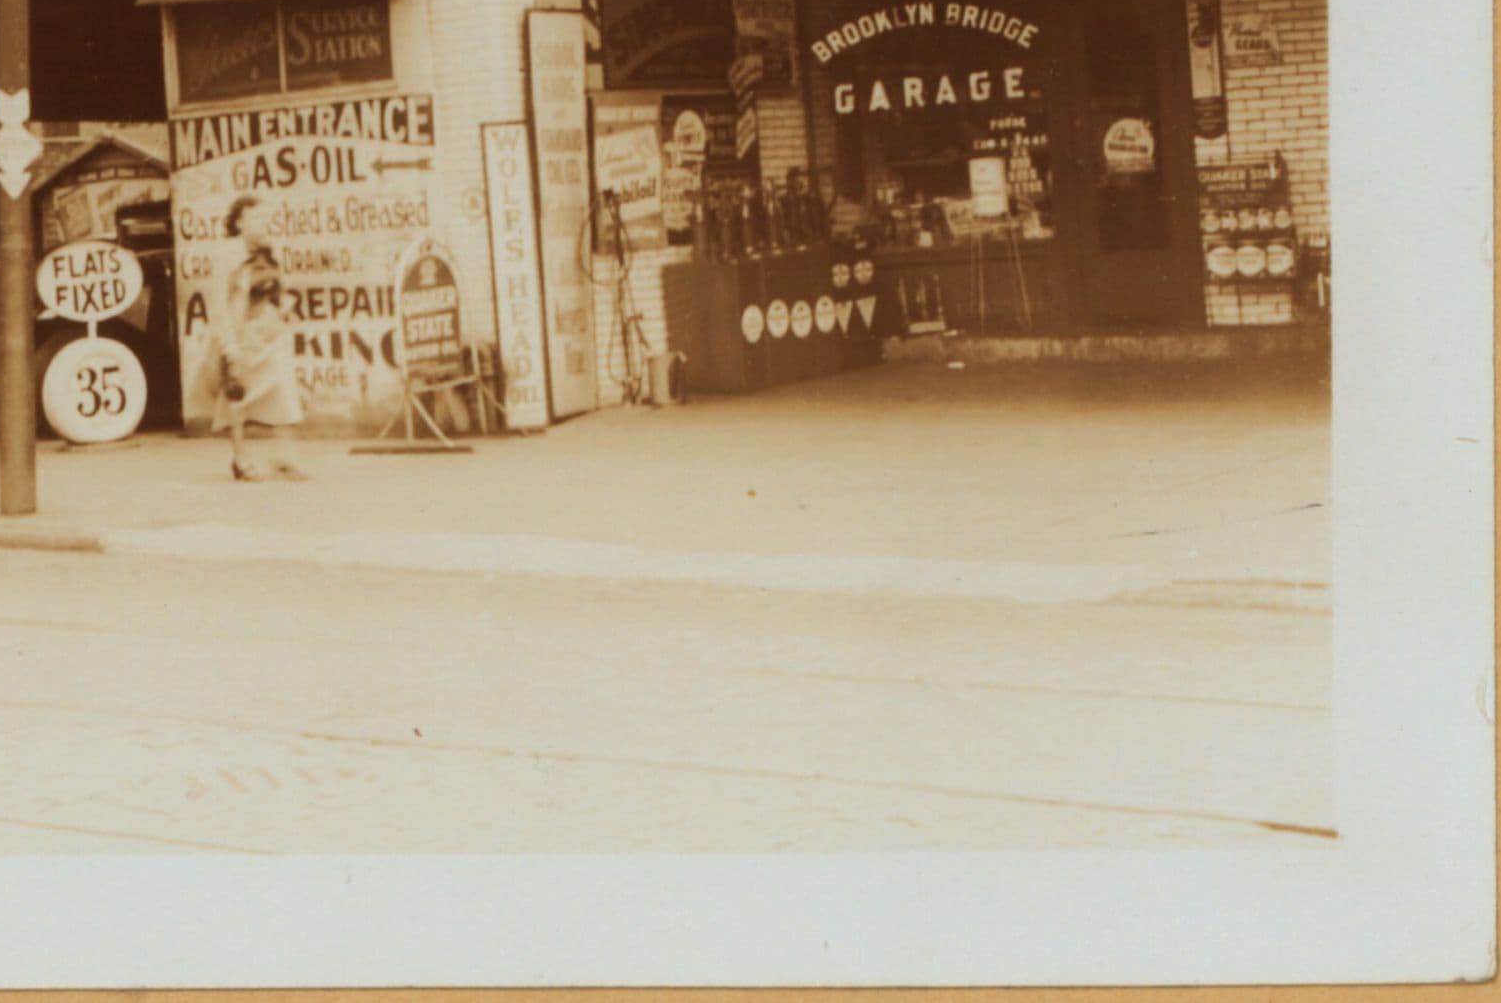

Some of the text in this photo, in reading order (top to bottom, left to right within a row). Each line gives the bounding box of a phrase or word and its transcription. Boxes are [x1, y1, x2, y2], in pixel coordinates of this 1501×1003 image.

[811, 2, 1040, 63] BROOKLYN BRIDGE
[834, 66, 1026, 115] GARAGE
[175, 96, 430, 168] MAIN ENTRANCE
[180, 188, 430, 242] Car shed & Greased
[53, 247, 122, 279] FLATS
[56, 279, 127, 316] FIXED
[75, 365, 128, 418] 35
